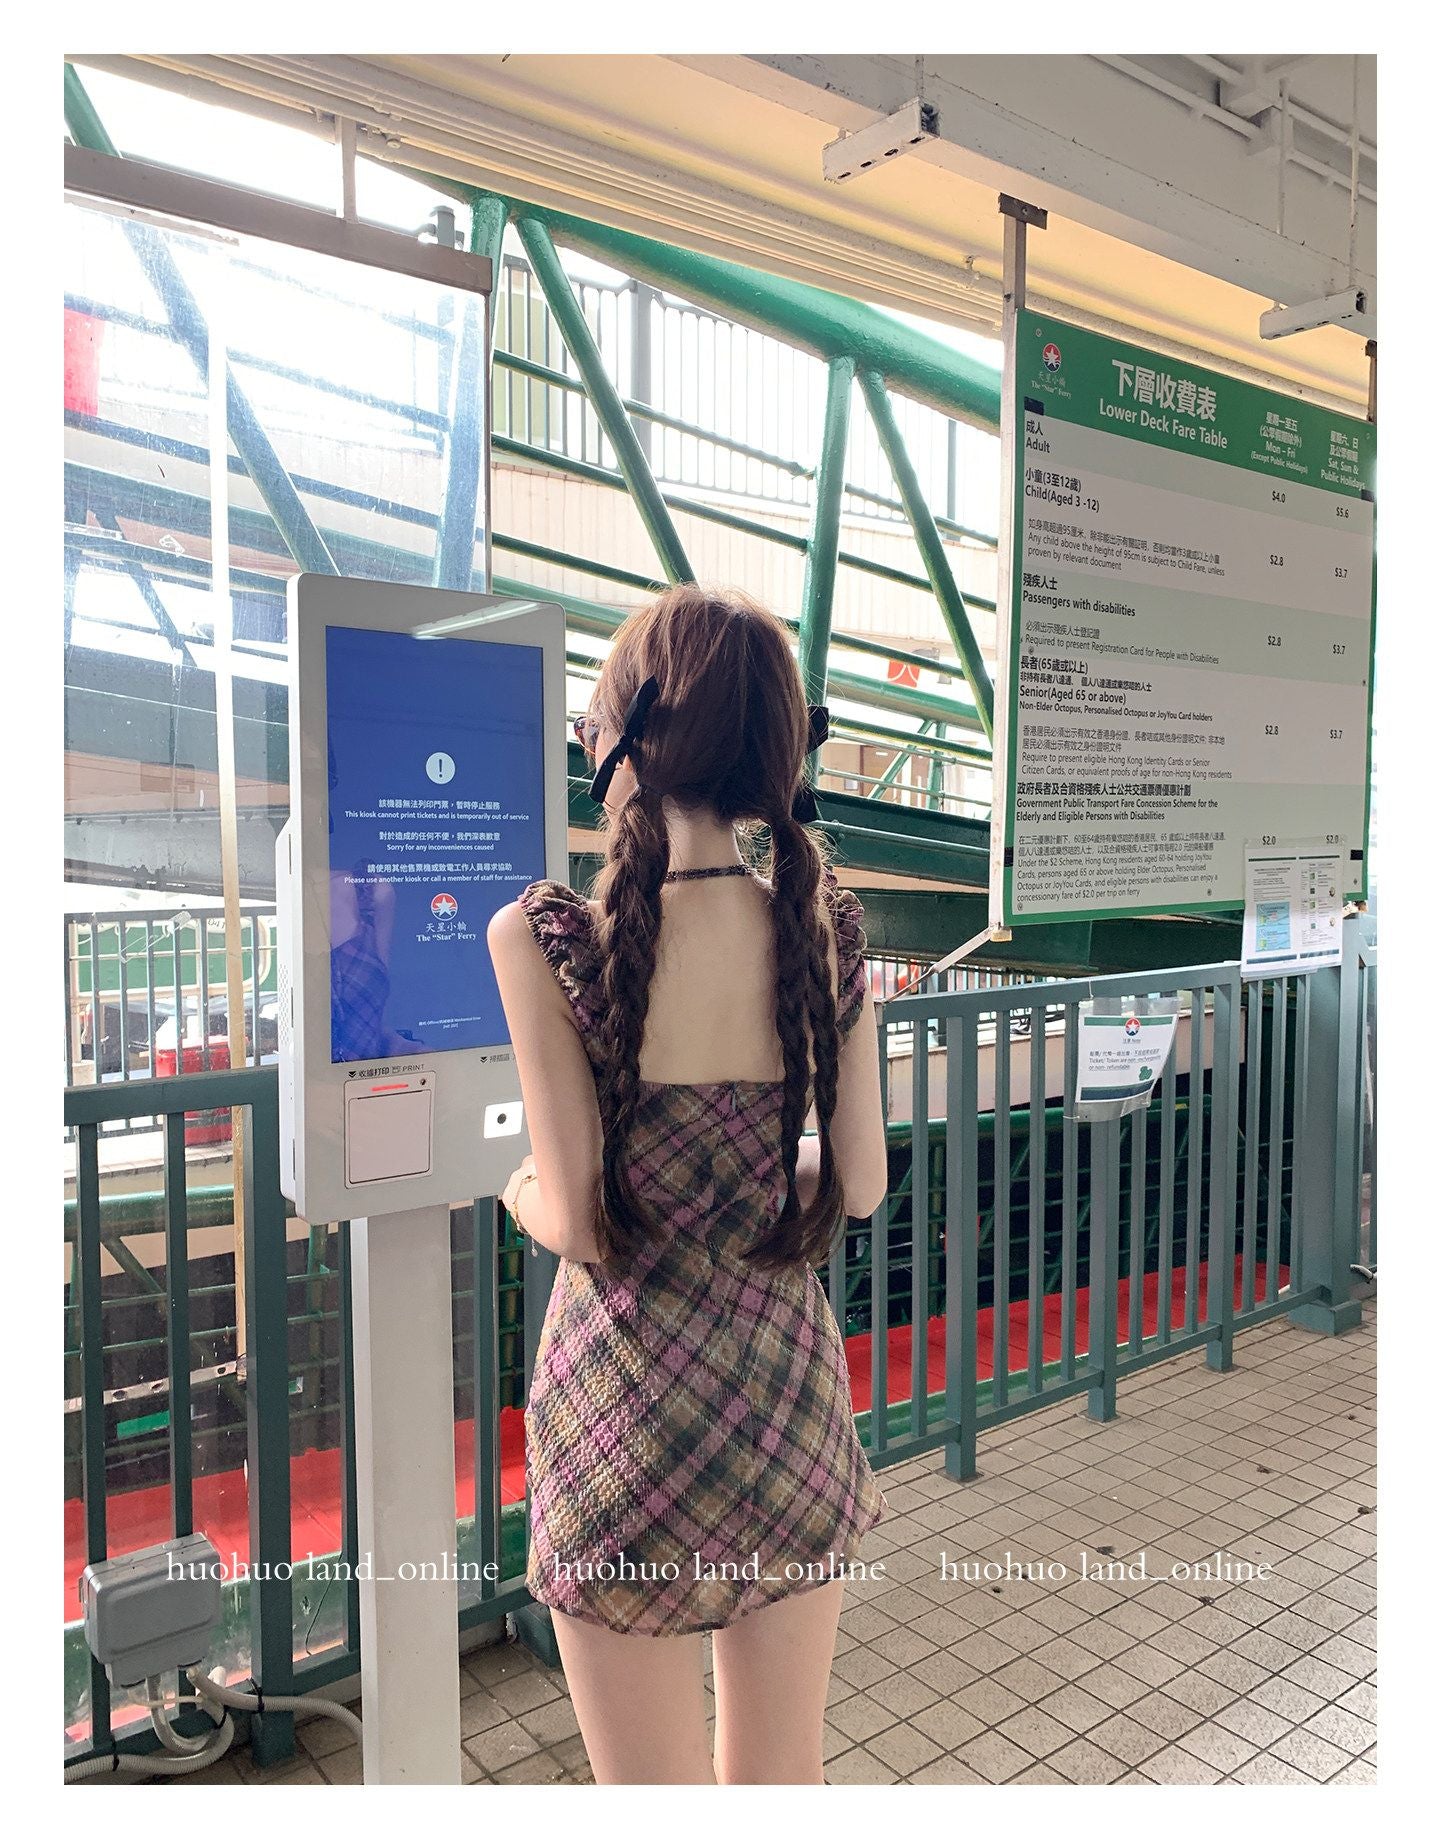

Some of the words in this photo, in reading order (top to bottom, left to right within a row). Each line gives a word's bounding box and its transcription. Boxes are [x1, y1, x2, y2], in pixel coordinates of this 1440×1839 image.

[1112, 359, 1216, 422] 下層收費表
[1026, 421, 1044, 436] 成人
[1100, 398, 1138, 423] Lower
[1140, 410, 1170, 432] Deck
[1172, 418, 1196, 440] Fare
[1200, 428, 1228, 448] Table
[1026, 437, 1050, 453] Adult
[1266, 441, 1280, 454] Mon
[1287, 447, 1296, 458] Fri
[1251, 451, 1269, 463] (Except
[1270, 456, 1285, 468] Public
[1286, 461, 1308, 474] Holidays)
[1340, 461, 1352, 472] Sun
[1026, 468, 1082, 492] 小童(3至12歲)
[1321, 469, 1339, 481] Public
[1340, 474, 1366, 491] Holidays
[1025, 485, 1073, 507] Child(Aged
[1075, 496, 1081, 507] 3
[1083, 499, 1100, 513] -12)
[1272, 491, 1286, 503] $4.0
[1336, 506, 1349, 518] $5.6
[1028, 533, 1041, 545] Any
[1043, 536, 1058, 546] child
[1061, 539, 1080, 550] above
[1082, 542, 1092, 552] the
[1094, 544, 1114, 558] height
[1124, 549, 1140, 561] 95cm
[1148, 554, 1169, 567] subject
[1177, 558, 1192, 570] Child
[1207, 564, 1225, 576] unless
[1028, 548, 1050, 559] proven
[1051, 550, 1062, 563] by
[1063, 553, 1088, 565] relevant
[1090, 556, 1122, 571] document
[1270, 554, 1284, 566] $2.8
[1334, 568, 1348, 579] $3.7
[1023, 572, 1058, 590] 殘疾人士
[1023, 591, 1070, 609] Passengers
[1073, 599, 1091, 611] with
[1093, 601, 1136, 617] disabilities
[1268, 635, 1281, 646] $2.8
[1025, 635, 1055, 647] Required
[1057, 638, 1064, 648] to
[1066, 642, 1090, 651] present
[1092, 642, 1128, 655] Registration
[1130, 646, 1144, 657] Card
[1145, 648, 1154, 658] for
[1156, 649, 1175, 662] People
[1176, 652, 1188, 661] with
[1190, 653, 1219, 664] Disabilities
[1333, 644, 1346, 654] $3.7
[1020, 656, 1088, 675] 長者(65歲或以上)
[1020, 686, 1073, 702] Senior(Aged
[1076, 690, 1086, 701] 65
[1088, 693, 1097, 702] or
[1099, 692, 1126, 706] above)
[1020, 702, 1053, 712] Non-Elder
[1054, 704, 1082, 715] Octopus,
[1084, 705, 1122, 716] Personalised
[1124, 708, 1148, 719] Octopus
[1157, 710, 1177, 721] JoyYou
[1178, 711, 1191, 720] Card
[1193, 712, 1213, 722] holders
[1265, 725, 1279, 735] $2.8
[1330, 729, 1343, 739] $3.7
[1022, 752, 1048, 764] Require
[1058, 754, 1082, 765] present
[1084, 754, 1107, 766] eligible
[1108, 755, 1125, 766] Hong
[1127, 755, 1143, 767] Kong
[1144, 756, 1167, 767] Identity
[1167, 757, 1184, 766] Cards
[1193, 757, 1210, 766] Senior
[1016, 798, 1061, 808] Government
[1063, 799, 1085, 808] Public
[1087, 799, 1119, 810] Transport
[1121, 799, 1135, 808] Fare
[1136, 799, 1171, 808] Concession
[1173, 799, 1196, 808] Scheme
[1198, 799, 1206, 808] for
[1208, 799, 1218, 808] the
[345, 811, 359, 819] This
[417, 811, 437, 819] tickets
[457, 812, 491, 821] temporarily
[1016, 811, 1041, 823] Elderly
[1042, 811, 1056, 820] and
[1058, 811, 1084, 823] Eligible
[1086, 811, 1112, 820] Persons
[1114, 811, 1128, 820] with
[1130, 811, 1165, 820] Disabilities
[1262, 836, 1276, 845] $2.0
[1326, 834, 1339, 844] $2.0
[387, 844, 404, 852] Sorry
[405, 844, 414, 852] for
[416, 845, 427, 853] any
[428, 844, 473, 852] inconveniences
[1059, 858, 1083, 866] Scheme,
[1085, 857, 1100, 866] Hong
[1102, 856, 1117, 866] Kong
[1119, 856, 1142, 864] residents
[1144, 855, 1157, 864] aged
[1175, 854, 1193, 863] holding
[1194, 854, 1212, 862] JoyYou
[344, 876, 365, 885] Please
[366, 876, 378, 885] use
[378, 876, 404, 884] another
[1017, 892, 1060, 902] concessionary
[1061, 891, 1073, 899] fare
[1082, 890, 1094, 899] $2.0
[1095, 891, 1106, 900] per
[1107, 889, 1117, 899] trip
[1127, 888, 1140, 898] ferry
[426, 921, 467, 932] 天星小輪
[458, 932, 476, 941] Ferry
[402, 1064, 425, 1072] PRINT
